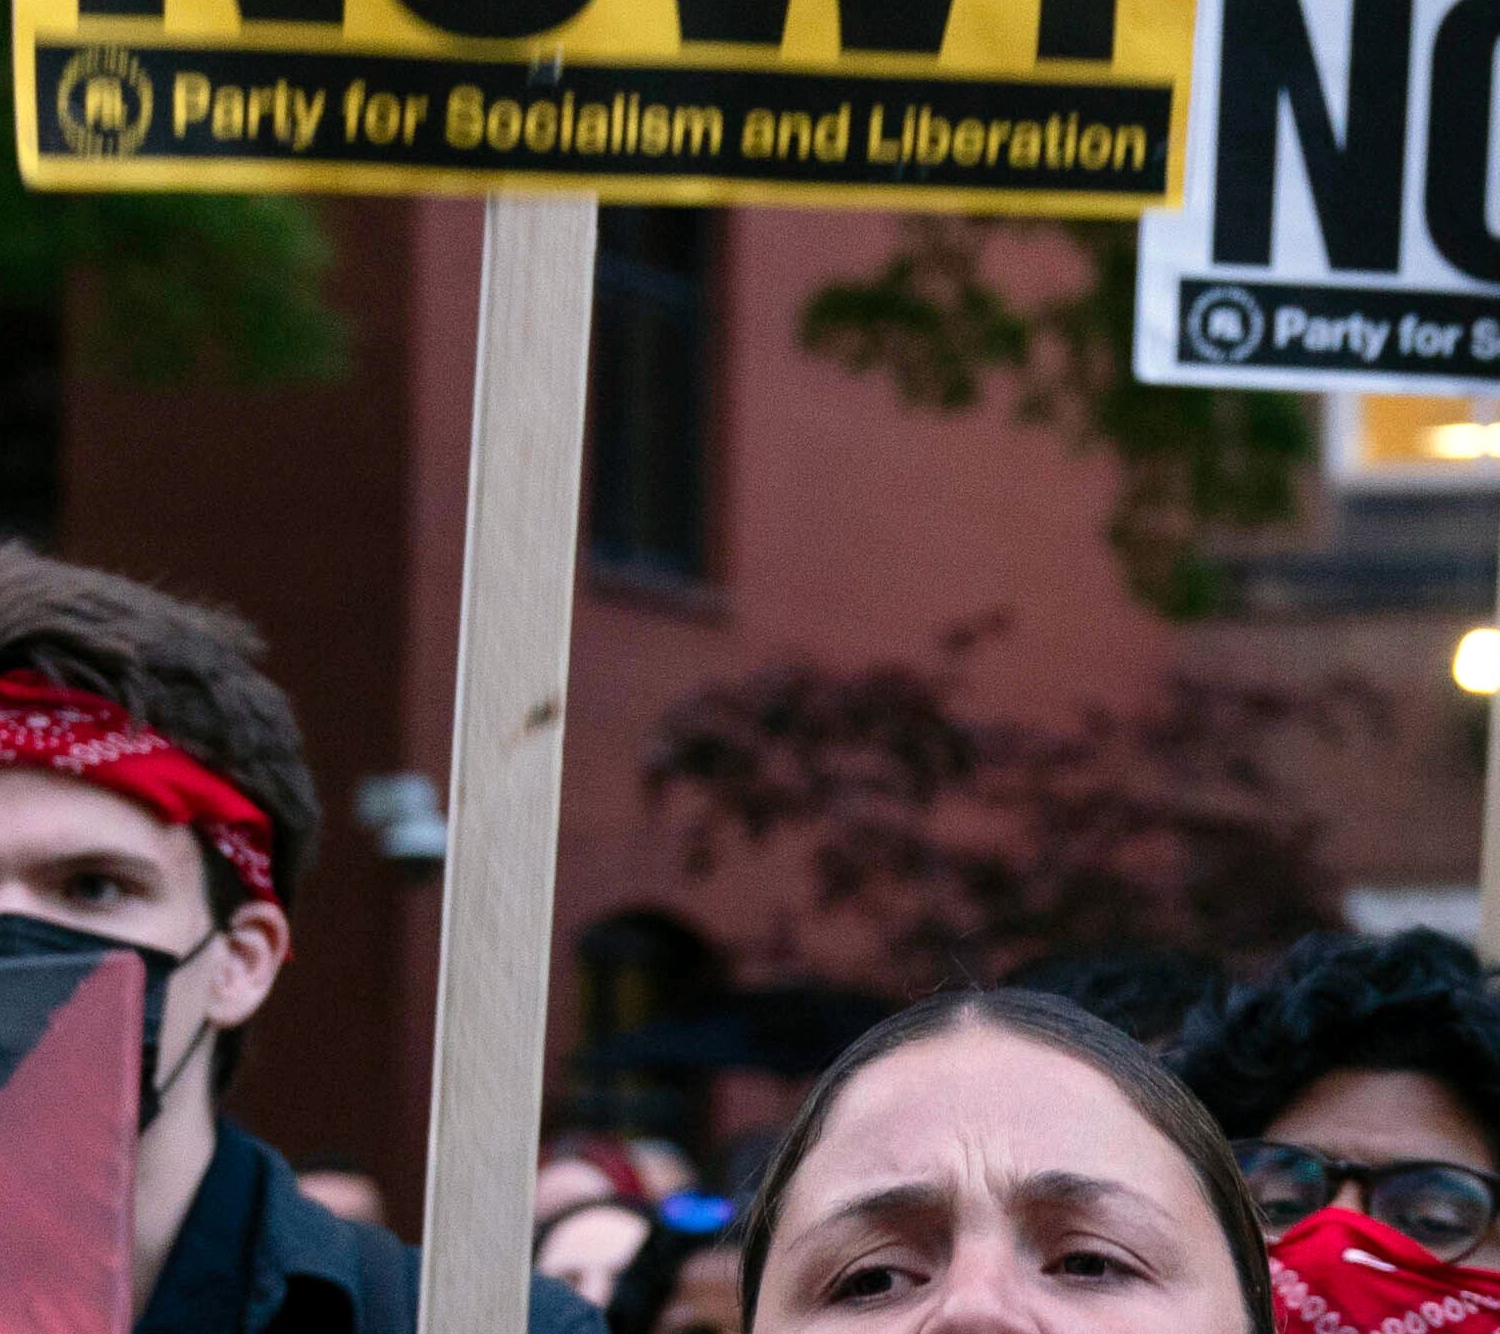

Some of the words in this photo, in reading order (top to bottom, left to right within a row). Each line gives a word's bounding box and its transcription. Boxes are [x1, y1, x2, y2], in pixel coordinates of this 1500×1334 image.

[173, 70, 326, 152] Party
[343, 77, 429, 148] for
[444, 82, 724, 158] Socialism
[740, 102, 852, 163] and
[866, 102, 1148, 173] Liberation
[1272, 305, 1390, 363] Party
[1399, 311, 1464, 359] for
